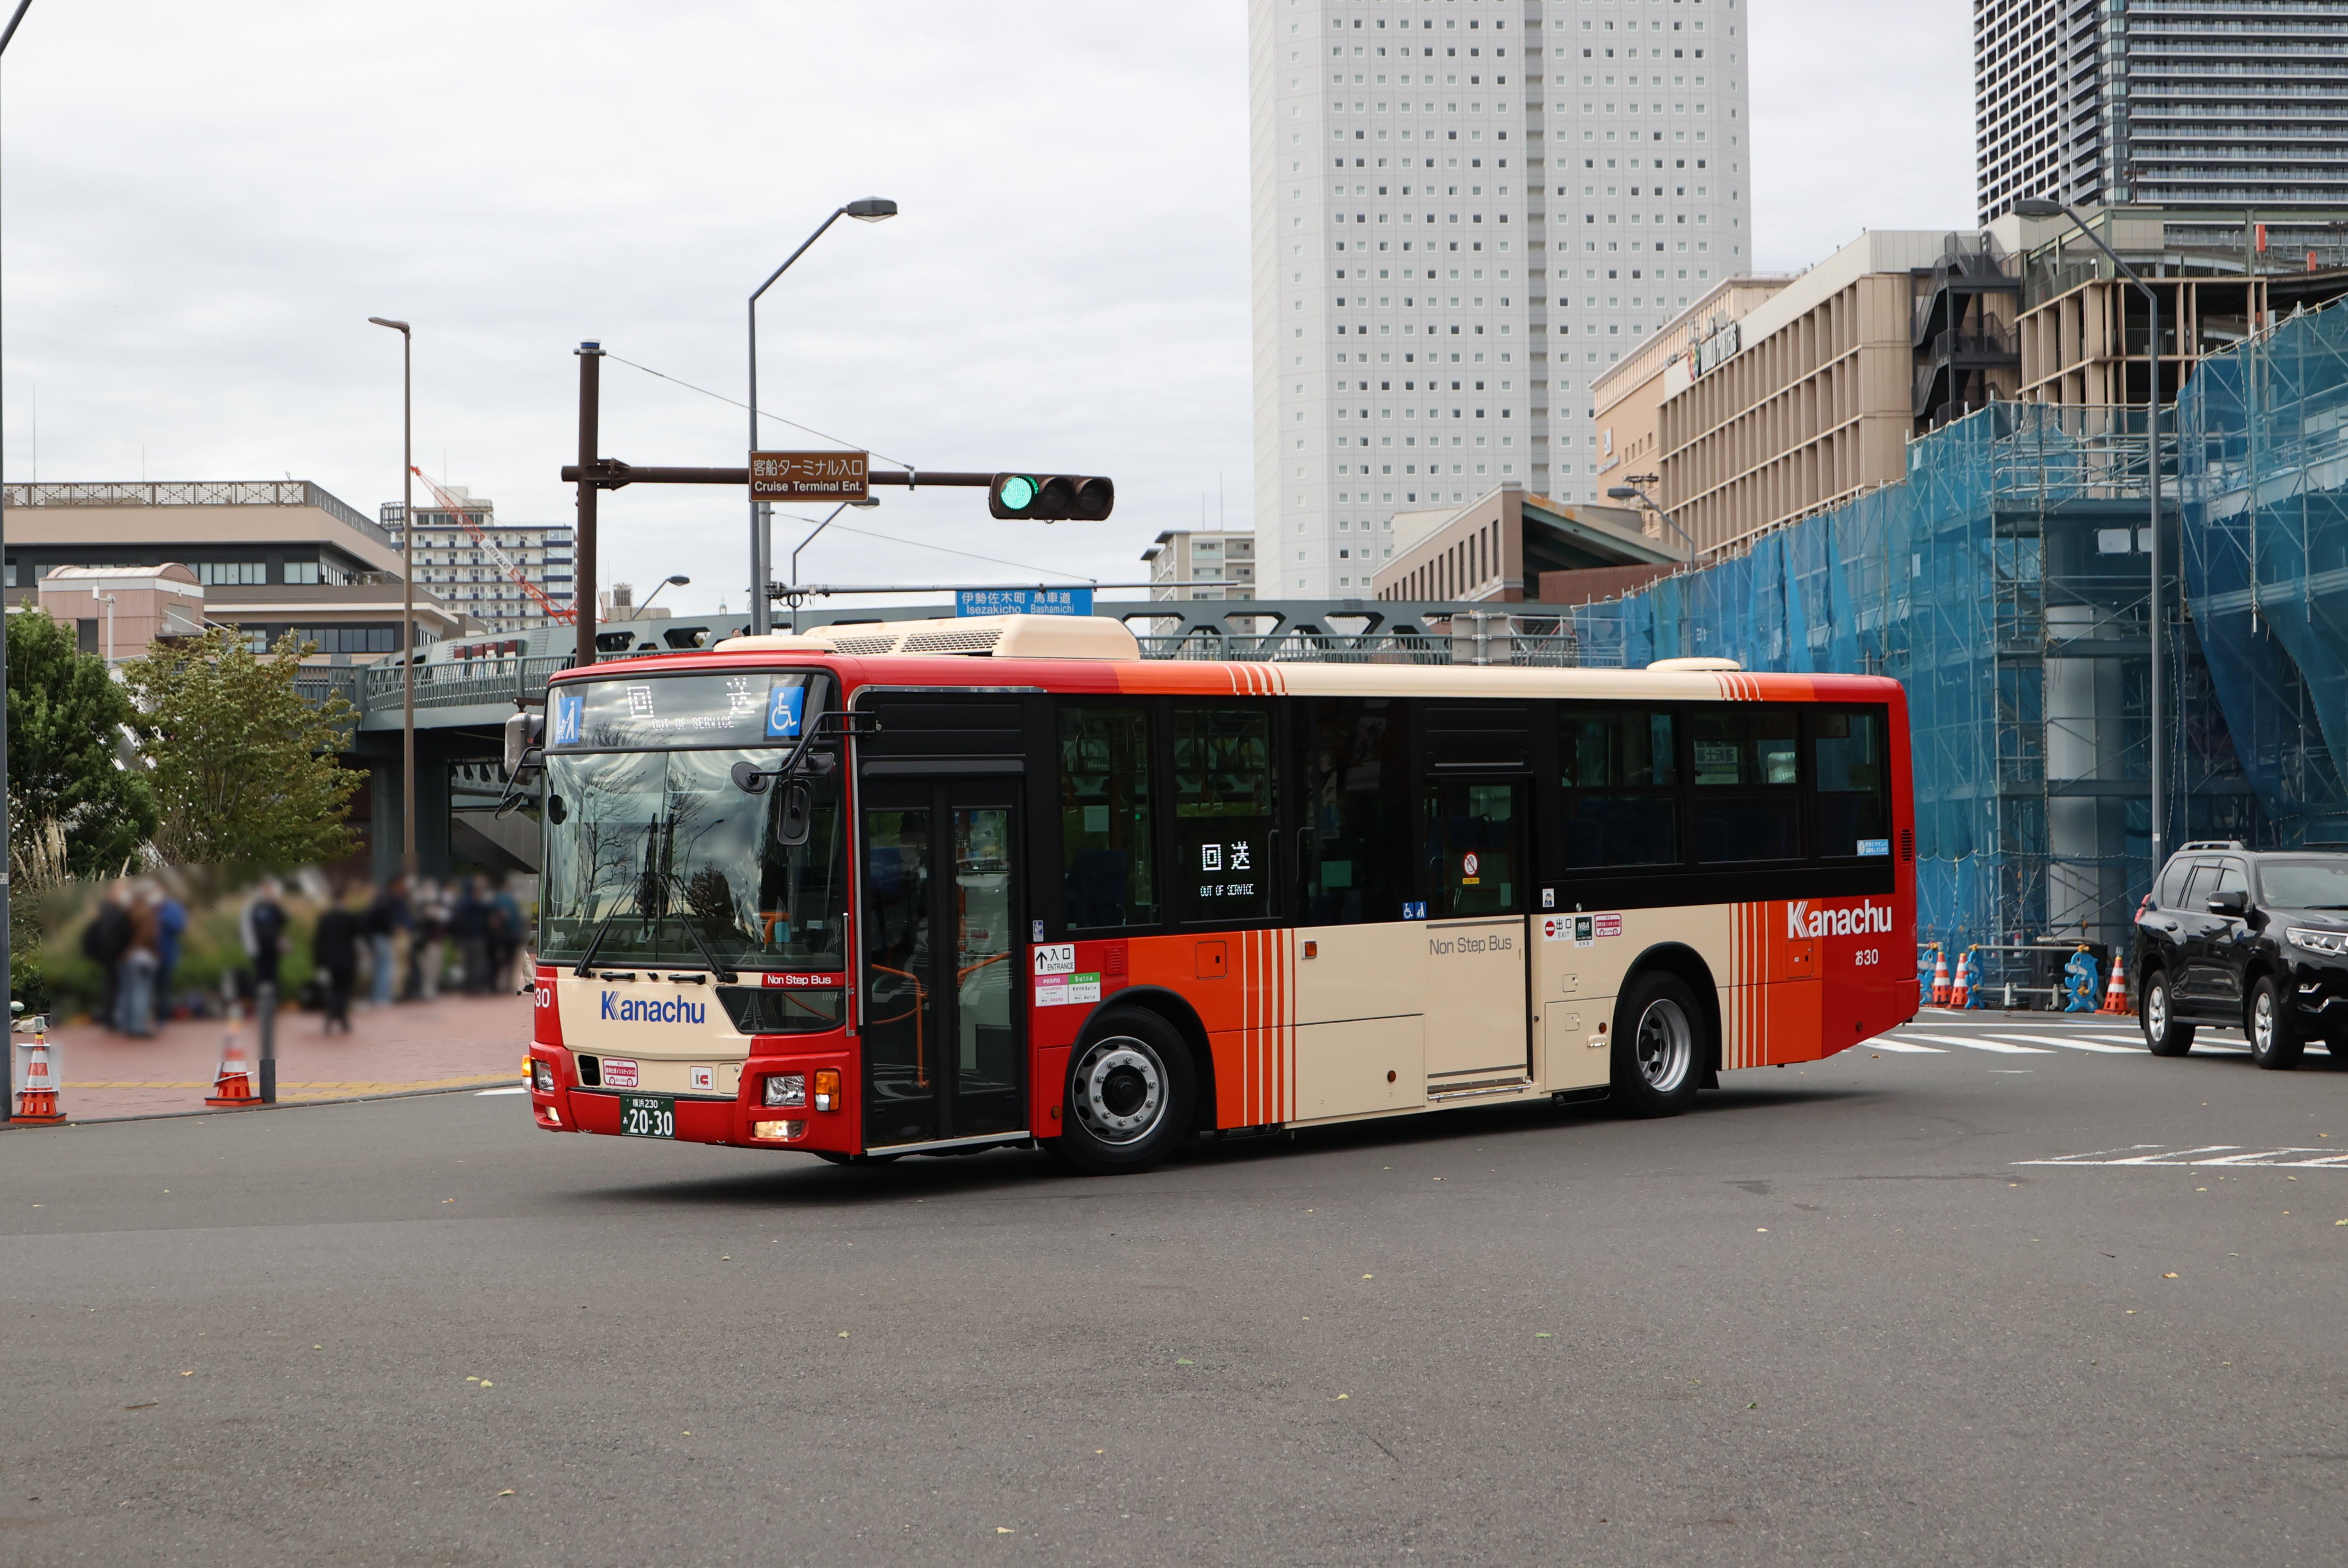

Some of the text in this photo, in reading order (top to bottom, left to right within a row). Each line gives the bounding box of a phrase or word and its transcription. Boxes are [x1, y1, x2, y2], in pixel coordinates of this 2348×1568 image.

[753, 459, 863, 476] 客船ターミナル入口
[755, 481, 863, 491] Cruise Terminal Ent.
[961, 591, 1071, 604] 伊勢佐木町 馬車道
[966, 604, 1075, 615] Isezakicho Bashamichi
[652, 715, 734, 730] OUT OF SERVICE
[1202, 841, 1251, 871] 回送
[1200, 883, 1254, 897] OUT OF SERVICE
[1556, 918, 1572, 930] 出口
[1578, 921, 1590, 929] NBA
[1787, 899, 1892, 939] Kanachu
[1430, 935, 1512, 955] Non Step Bus
[1050, 948, 1070, 961] 入口
[1855, 948, 1878, 966] お30
[1047, 962, 1074, 971] ENTRANCE
[767, 975, 832, 986] Non Step Bus
[601, 990, 705, 1024] Kanachu
[632, 1098, 658, 1109] 横浜230
[629, 1108, 673, 1136] 20-30
